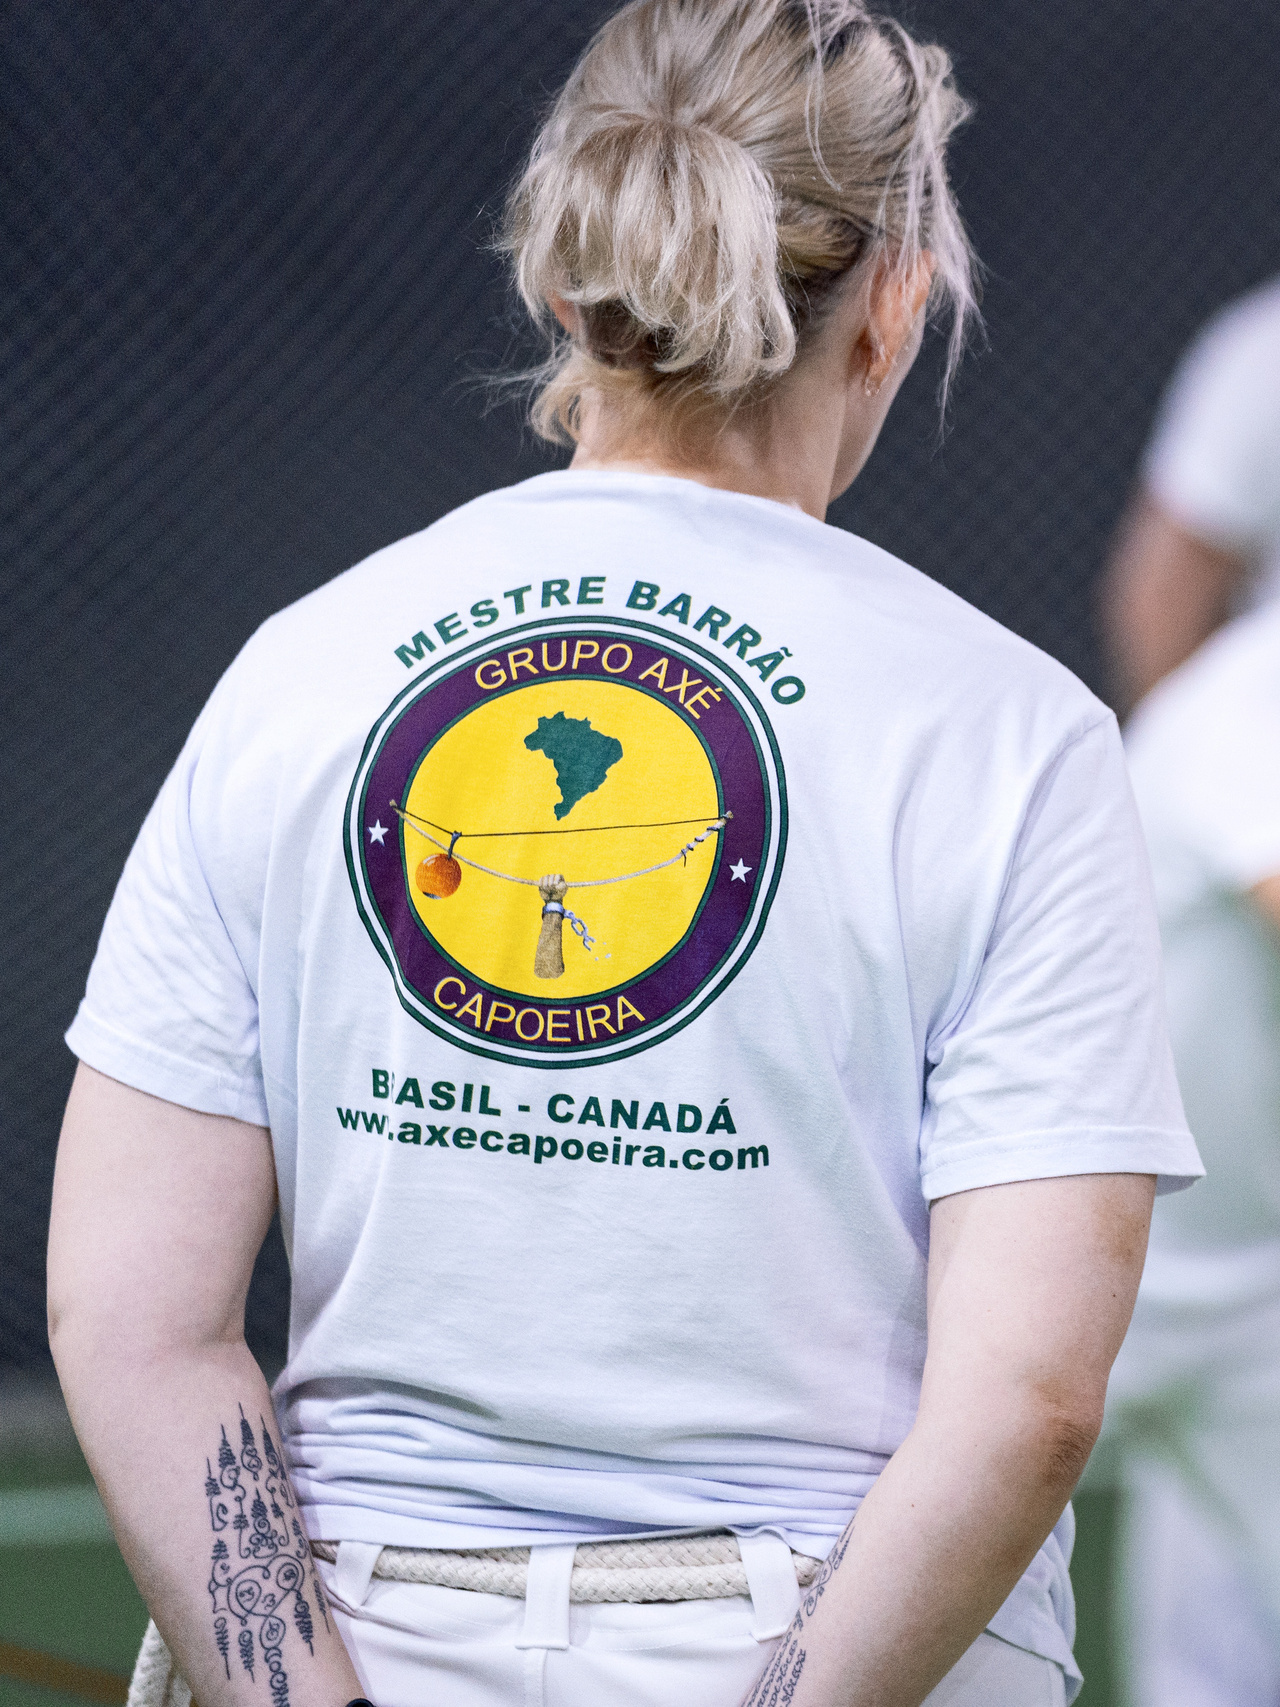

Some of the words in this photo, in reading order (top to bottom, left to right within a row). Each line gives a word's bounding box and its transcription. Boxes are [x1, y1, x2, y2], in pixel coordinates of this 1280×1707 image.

[394, 576, 607, 669] MESTRE
[625, 580, 807, 706] BARRÃO
[474, 640, 634, 690] GRUPO
[638, 657, 723, 720] AXÉ
[433, 977, 646, 1042] CAPOEIRA
[371, 1068, 501, 1116] BASIL
[547, 1093, 738, 1135] CANADÁ
[336, 1107, 770, 1172] ww.axecapoeira.com
